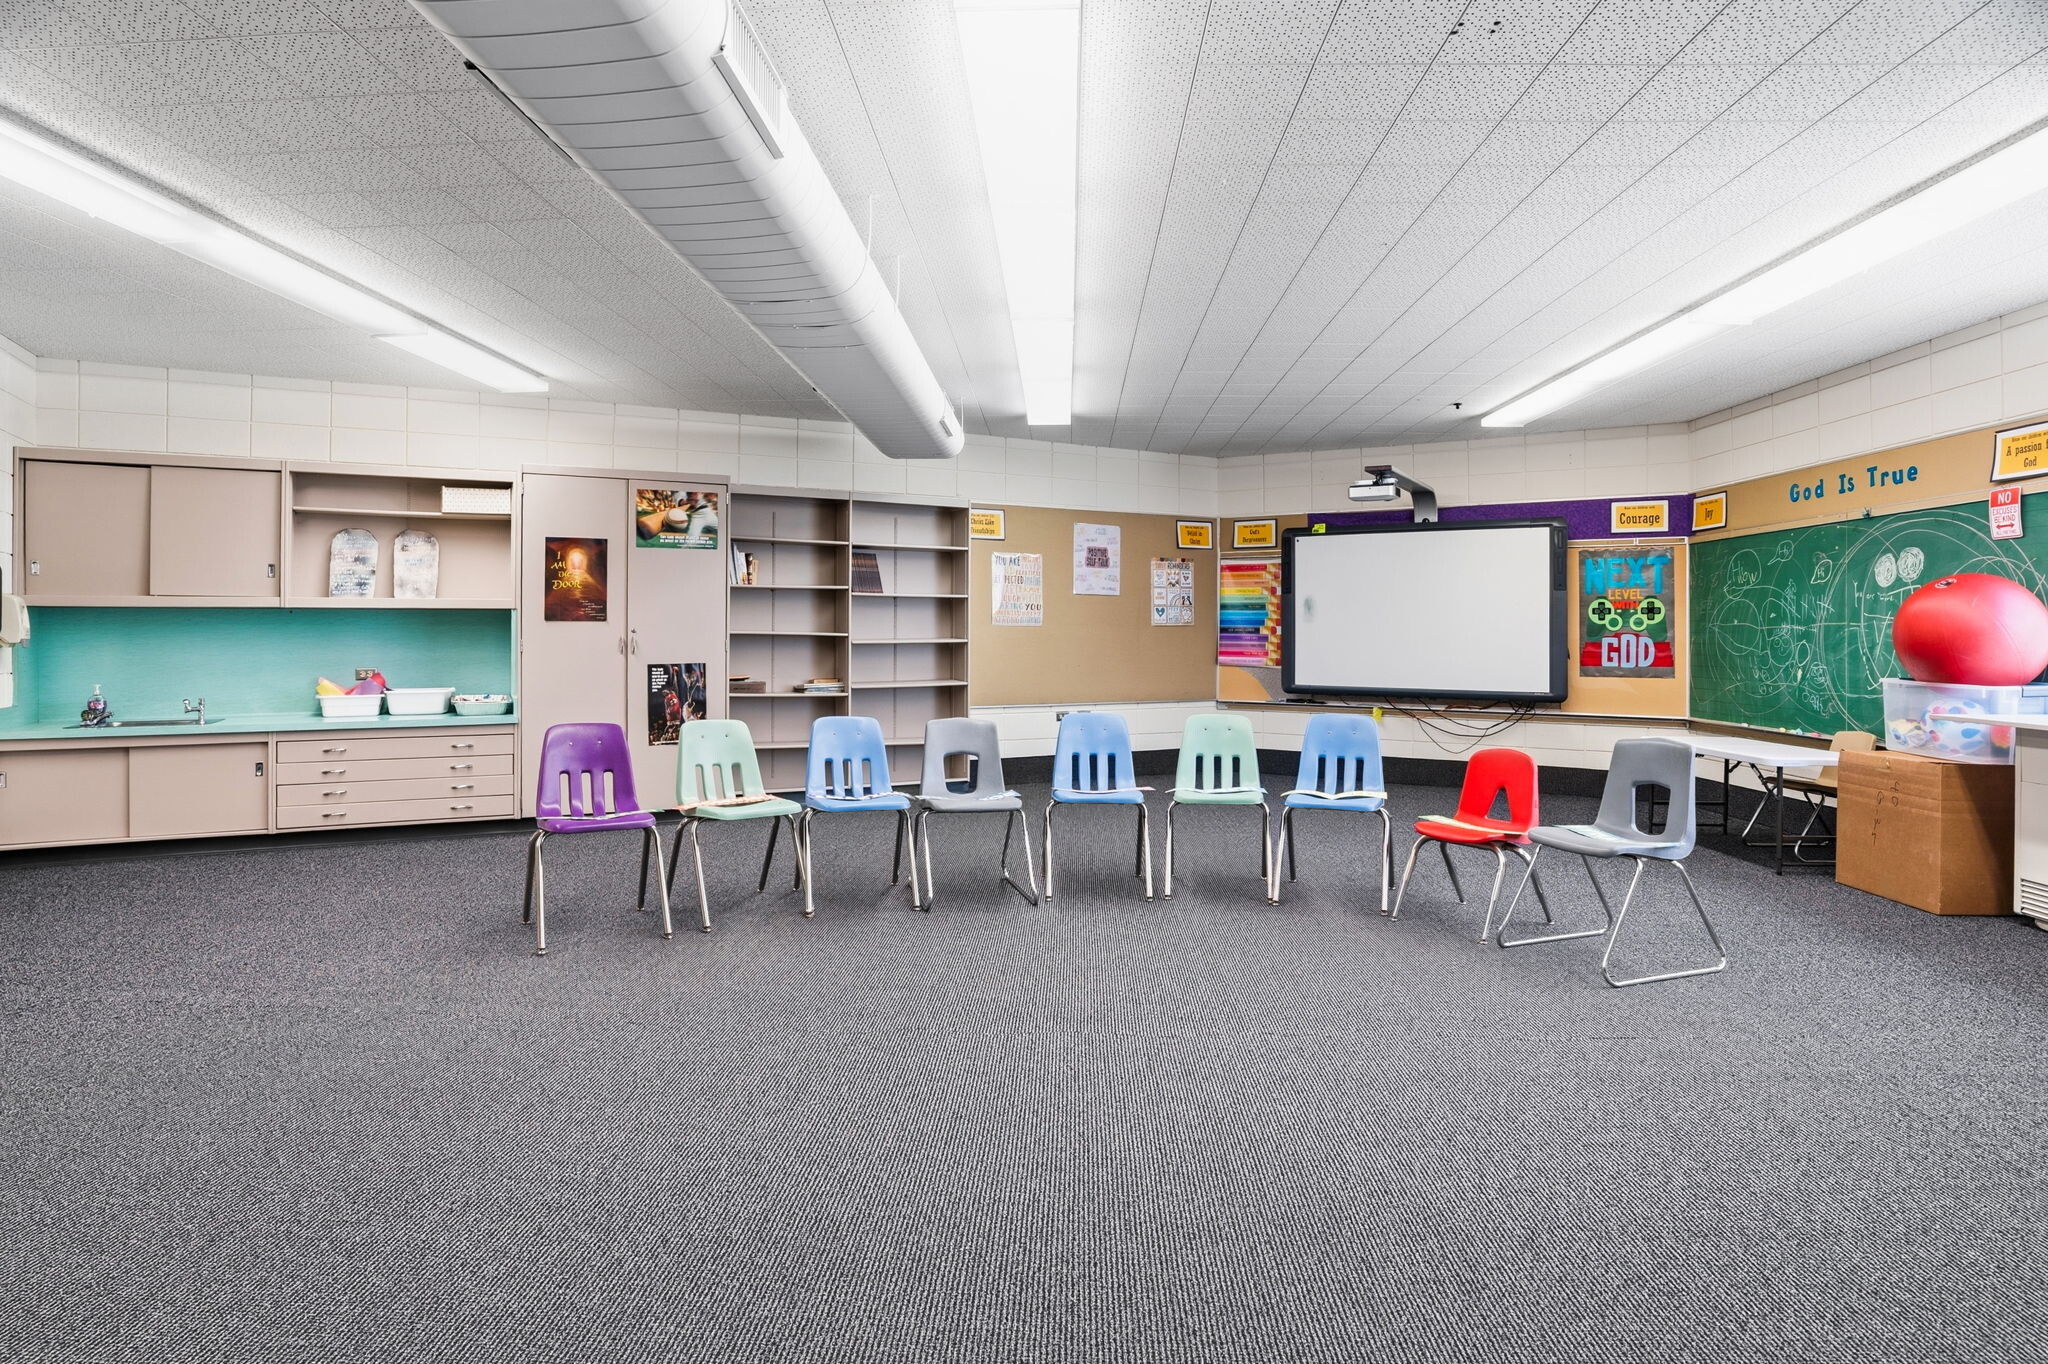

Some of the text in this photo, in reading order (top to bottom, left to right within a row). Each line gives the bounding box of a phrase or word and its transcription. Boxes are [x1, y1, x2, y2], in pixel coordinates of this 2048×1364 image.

[2006, 446, 2012, 456] A
[2015, 442, 2042, 457] passion
[2023, 456, 2037, 468] God
[1789, 465, 1918, 503] God Is True
[1997, 491, 2012, 504] NO
[1704, 508, 1714, 521] Joy
[1993, 506, 2017, 516] EXCUSES
[1619, 513, 1660, 526] Courage
[2002, 514, 2016, 522] KIND
[551, 561, 566, 569] AM
[994, 555, 1007, 566] YOU
[1009, 555, 1020, 566] ARE
[1584, 555, 1671, 595] NEXT
[1607, 589, 1644, 600] LEVEL
[1025, 603, 1042, 611] YOU
[1613, 600, 1639, 609] WITH
[1601, 634, 1656, 668] GOD
